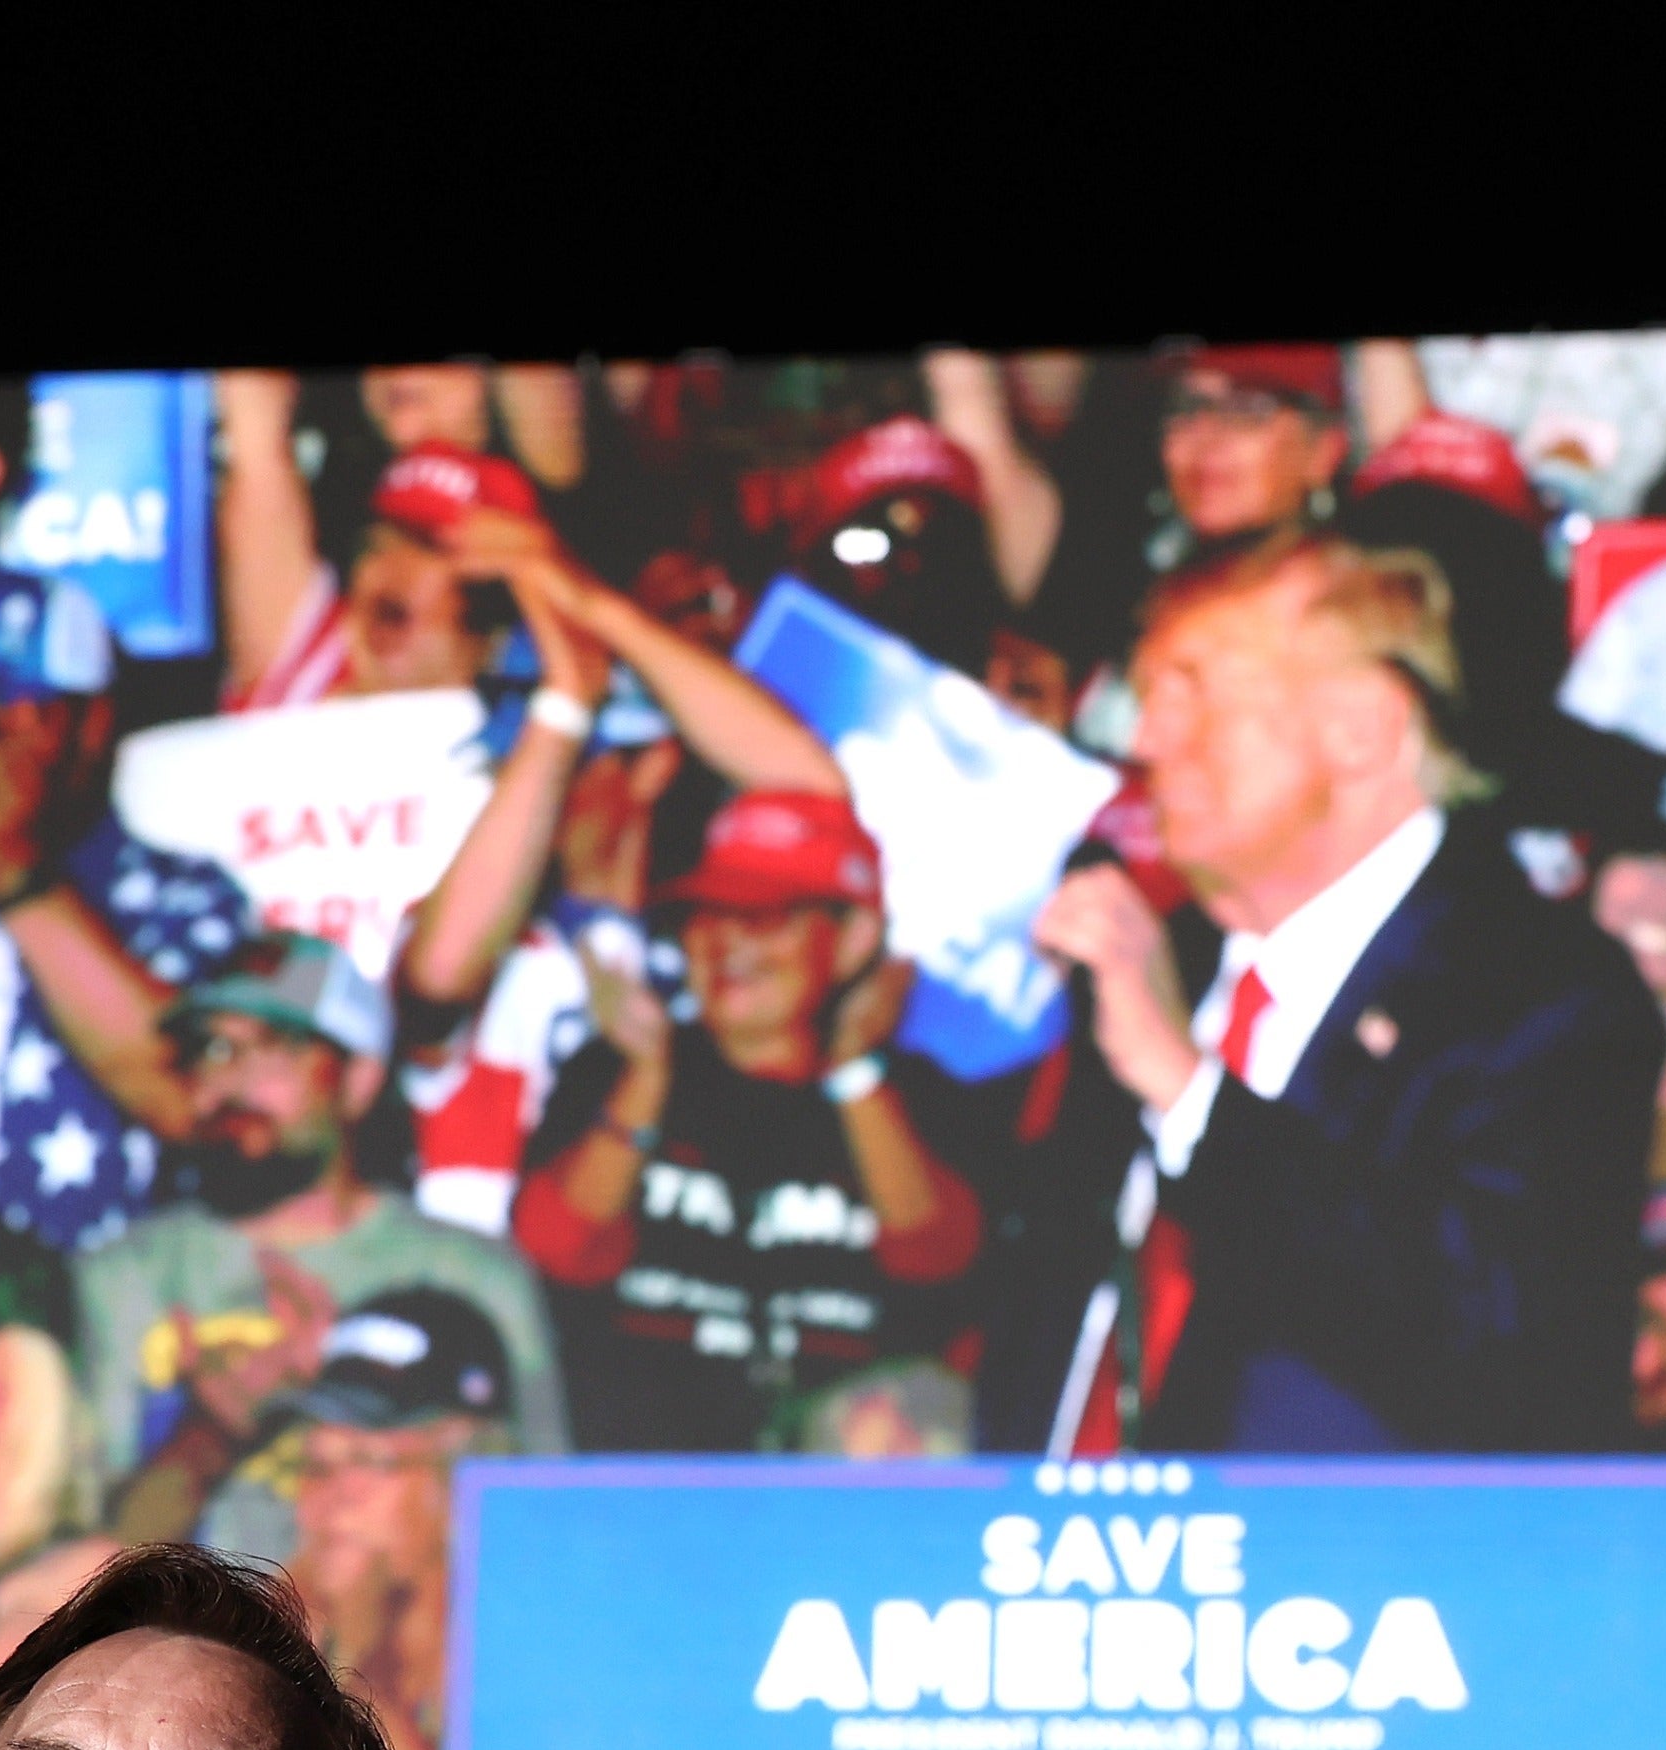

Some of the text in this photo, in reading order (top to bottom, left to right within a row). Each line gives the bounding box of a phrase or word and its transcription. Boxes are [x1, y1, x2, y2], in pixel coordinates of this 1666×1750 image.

[236, 797, 426, 864] SAVE
[980, 1513, 1247, 1597] SAVE
[752, 1595, 1470, 1713] AMERICA
